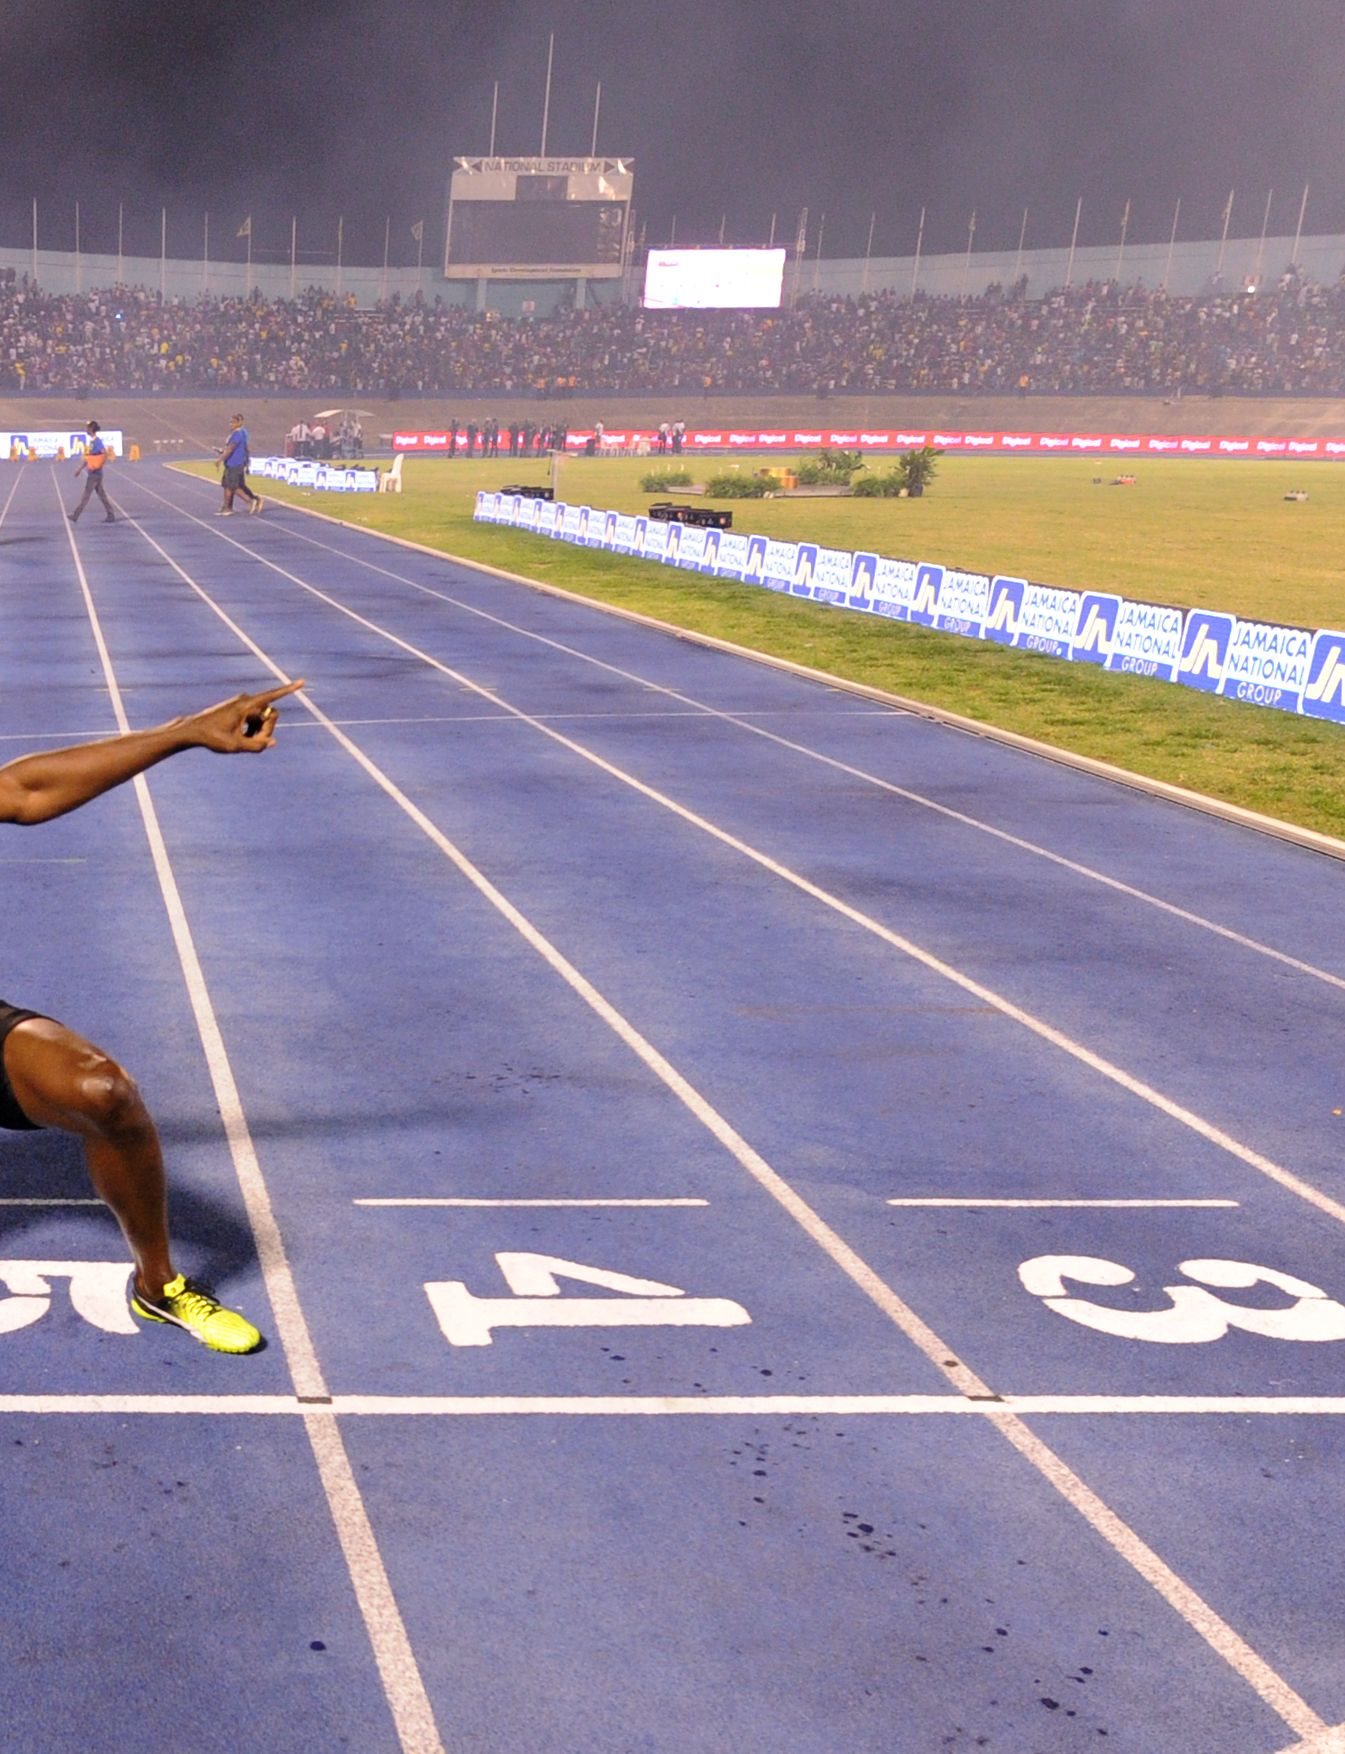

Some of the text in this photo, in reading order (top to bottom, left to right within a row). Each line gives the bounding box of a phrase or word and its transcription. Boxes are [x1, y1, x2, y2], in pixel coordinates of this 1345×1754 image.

[484, 160, 543, 172] NATIONAL
[943, 576, 987, 596] JAMAICA
[1025, 589, 1077, 614] JAMAICA
[1022, 611, 1074, 638] NATIONAL
[1119, 605, 1179, 634] JAMAICA
[1026, 635, 1058, 653] GROUP
[1116, 630, 1178, 659] NATIONAL
[1233, 627, 1307, 658] JAMAICA
[1121, 656, 1158, 676] GROUP
[1228, 653, 1305, 686] NATIONAL
[1237, 681, 1282, 705] GROUP
[423, 1251, 753, 1347] 4
[1016, 1254, 1345, 1344] 3
